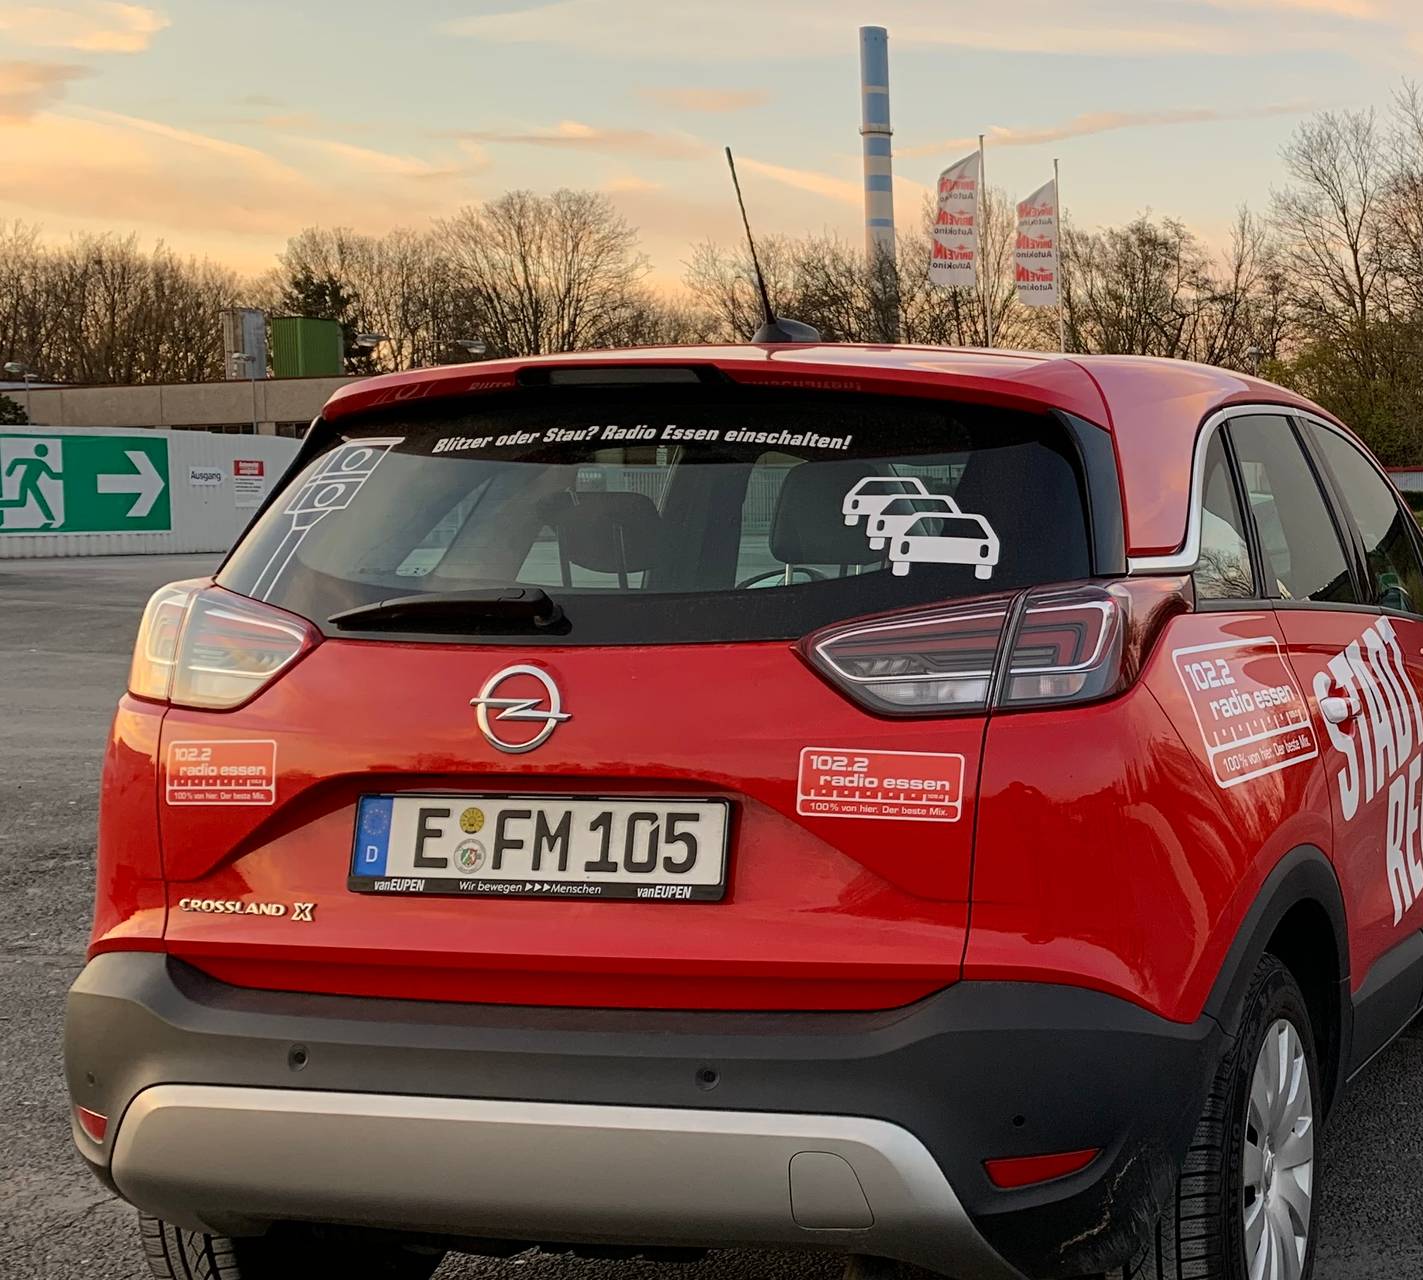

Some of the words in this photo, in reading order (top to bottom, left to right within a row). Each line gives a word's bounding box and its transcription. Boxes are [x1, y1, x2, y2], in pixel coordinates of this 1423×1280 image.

[432, 436, 493, 453] Blitzer
[495, 430, 540, 447] oder
[543, 425, 599, 443] Stau?
[600, 425, 657, 440] Radio
[660, 424, 720, 441] Essen
[724, 427, 853, 450] einschalten!
[190, 470, 221, 482] Ausgang
[1184, 659, 1236, 691] 102.2
[1209, 688, 1256, 720] radio
[1253, 685, 1295, 709] essen
[174, 748, 212, 761] 102.2
[179, 763, 217, 776] radio
[220, 766, 266, 776] essen
[810, 755, 869, 772] 102.2
[819, 773, 879, 788] radio
[883, 778, 950, 791] essen
[841, 805, 857, 813] von
[859, 804, 879, 814] hier.
[882, 805, 898, 814] Der
[901, 806, 926, 815] beste
[929, 807, 948, 816] Mix.
[413, 807, 451, 869] E
[491, 809, 572, 872] FM
[584, 810, 700, 874] 105
[365, 845, 378, 863] D
[374, 879, 425, 892] vanEUPEN
[459, 880, 476, 891] Wir
[477, 881, 522, 894] bewegen
[551, 883, 602, 895] Menschen
[637, 885, 692, 899] vanEUPEN
[179, 898, 286, 916] CROSSLAND
[291, 902, 315, 921] X
